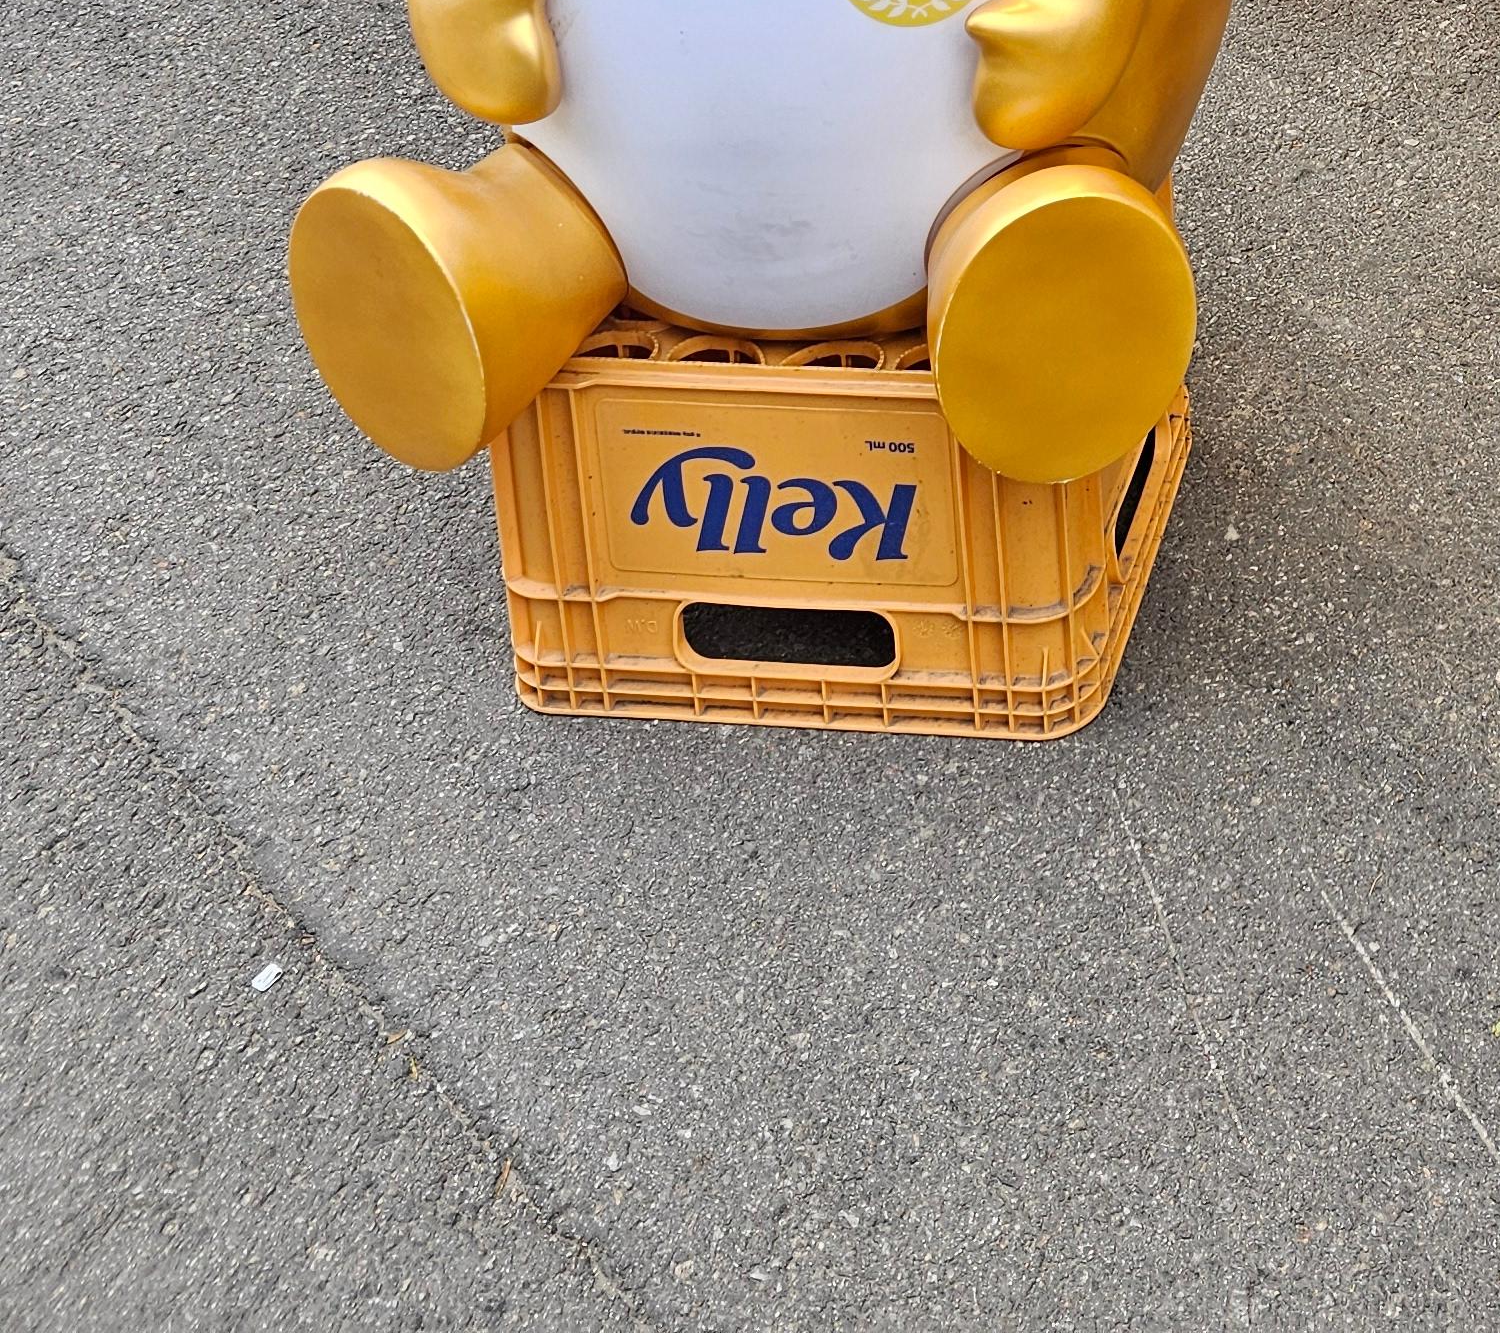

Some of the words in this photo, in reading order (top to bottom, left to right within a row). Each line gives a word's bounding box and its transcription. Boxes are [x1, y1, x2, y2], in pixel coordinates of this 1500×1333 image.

[864, 439, 886, 452] mL
[888, 440, 915, 454] 500
[630, 446, 918, 562] Kelly
